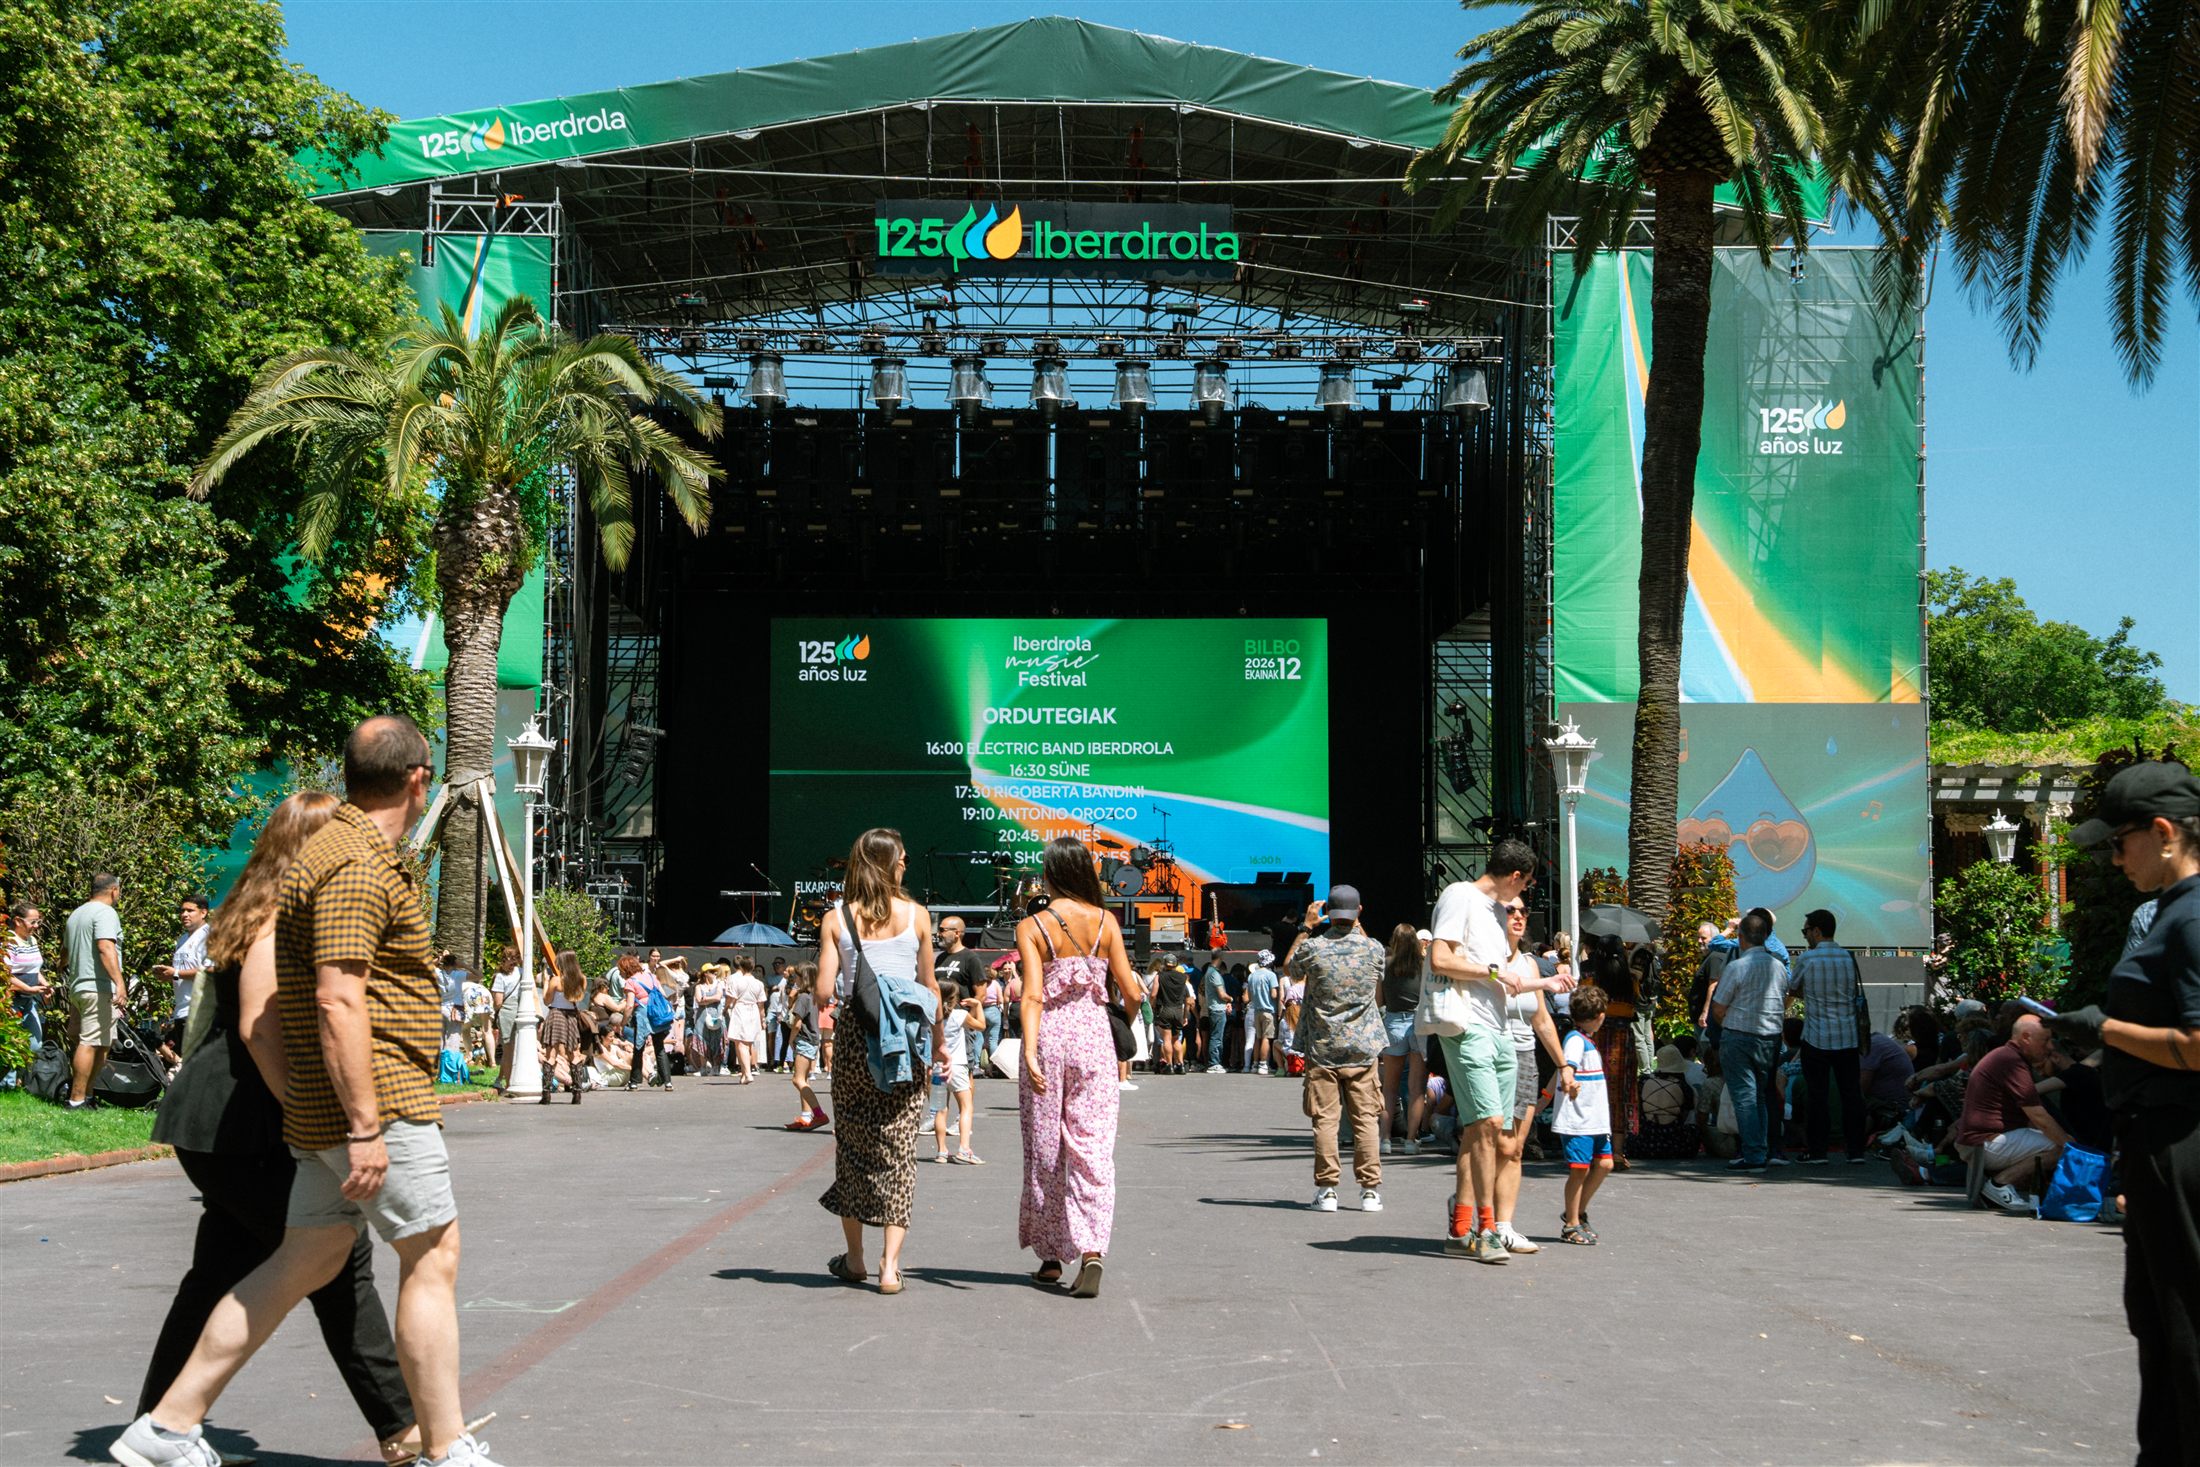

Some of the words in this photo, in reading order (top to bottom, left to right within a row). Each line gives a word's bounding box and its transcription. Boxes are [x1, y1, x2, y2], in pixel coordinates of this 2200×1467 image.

[418, 131, 460, 158] 125
[509, 108, 627, 146] Iberdrola
[874, 218, 944, 257] 125
[1034, 221, 1240, 261] Iberdrola
[1760, 407, 1805, 434] 125
[1760, 436, 1809, 455] años
[1814, 436, 1843, 455] luz
[1013, 636, 1092, 652] Iberdrola
[1244, 639, 1300, 655] BILBO
[798, 641, 836, 664] 125
[1005, 653, 1100, 672] music
[1244, 657, 1275, 669] 2026
[1277, 657, 1302, 680] 12
[798, 665, 840, 681] años
[843, 665, 867, 681] luz
[1018, 671, 1087, 687] Festival
[1244, 669, 1279, 680] EKAINAK
[982, 707, 1117, 725] ORDUTEGIAK
[925, 741, 964, 756] 16:00
[966, 741, 1040, 756] ELECTRIC
[1042, 741, 1085, 756] BAND
[1087, 741, 1174, 756] IBERDROLA
[1009, 763, 1046, 777] 16:30
[1048, 760, 1090, 777] SÜNE
[954, 785, 991, 799] 17:30
[994, 785, 1078, 799] RIGOBERTA
[1082, 785, 1145, 799] BANDINI
[961, 807, 996, 821] 19:10
[997, 807, 1068, 821] ANTONIO
[1071, 807, 1138, 821] OROZCO
[998, 829, 1040, 843] 20:45
[1014, 850, 1045, 865] SHO
[1249, 855, 1274, 865] 16:00
[1275, 855, 1282, 865] h
